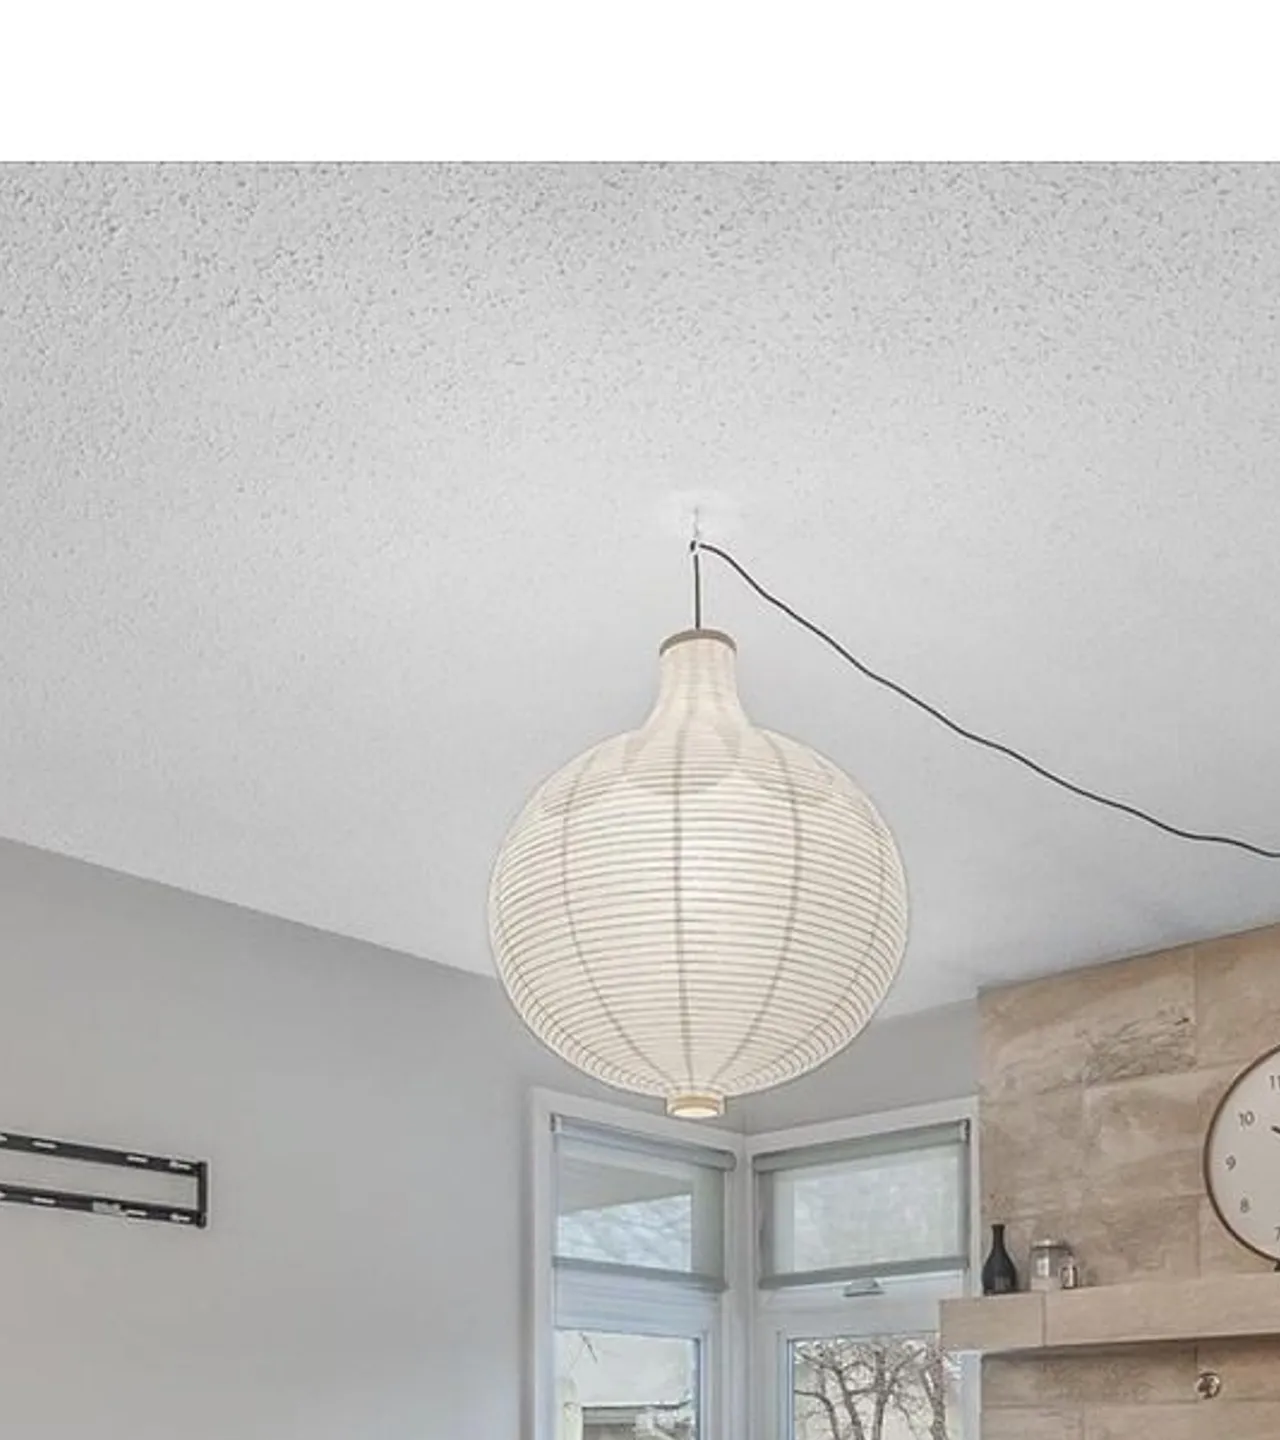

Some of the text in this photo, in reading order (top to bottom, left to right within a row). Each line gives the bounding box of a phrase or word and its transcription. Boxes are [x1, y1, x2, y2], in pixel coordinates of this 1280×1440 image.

[1239, 1112, 1255, 1126] 10
[1225, 1156, 1236, 1171] 9
[1240, 1199, 1250, 1213] 8
